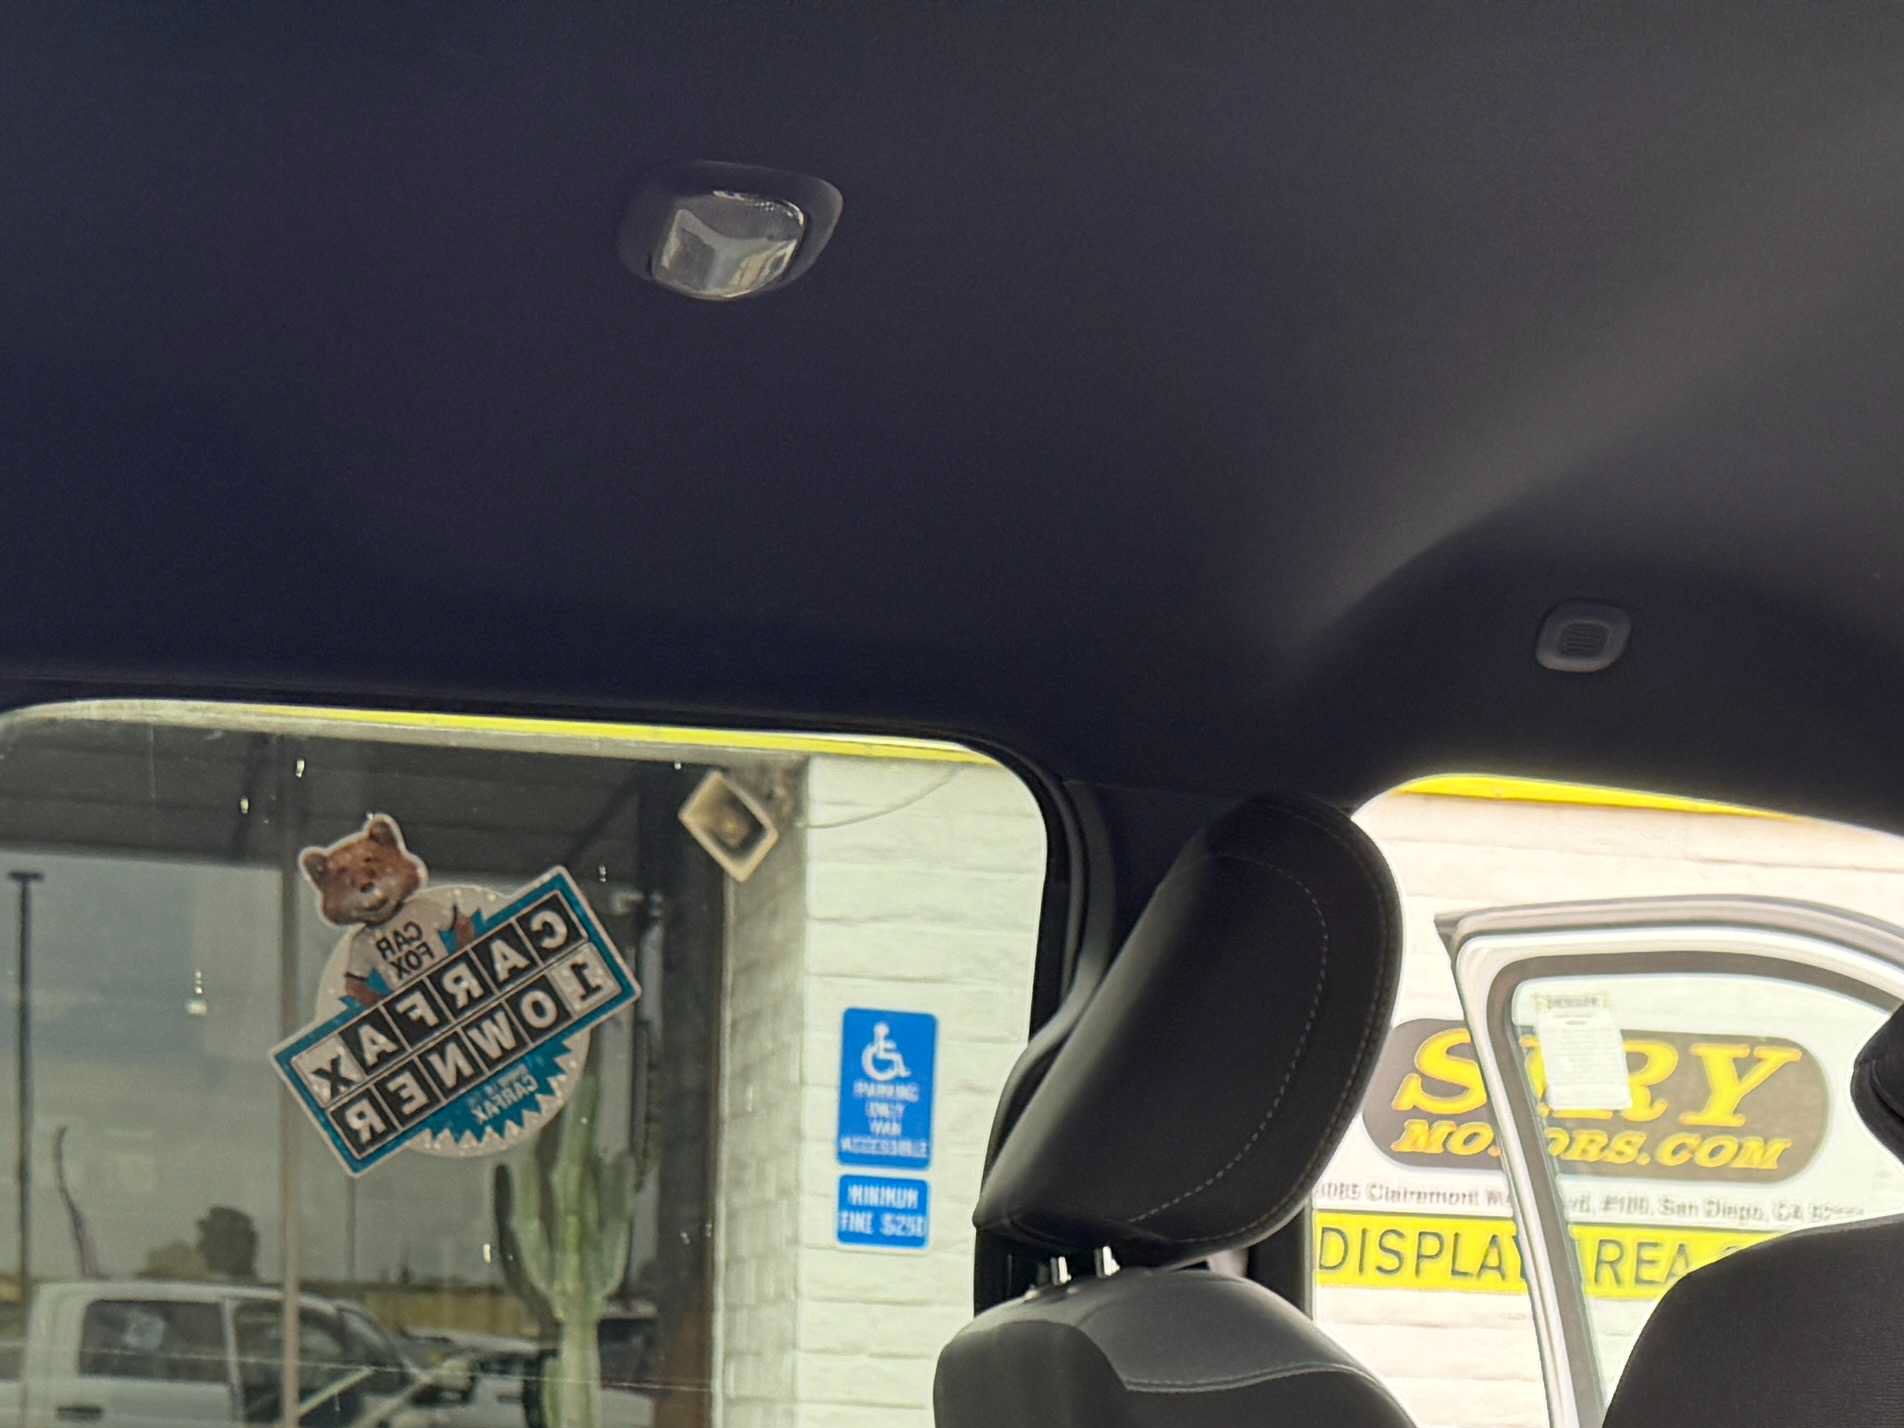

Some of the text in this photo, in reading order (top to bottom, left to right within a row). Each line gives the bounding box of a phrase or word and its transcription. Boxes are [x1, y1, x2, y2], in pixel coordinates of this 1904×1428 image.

[848, 1184, 919, 1209] MINIMUM
[840, 1211, 873, 1234] FINE
[1318, 1225, 1524, 1282] DISPLA
